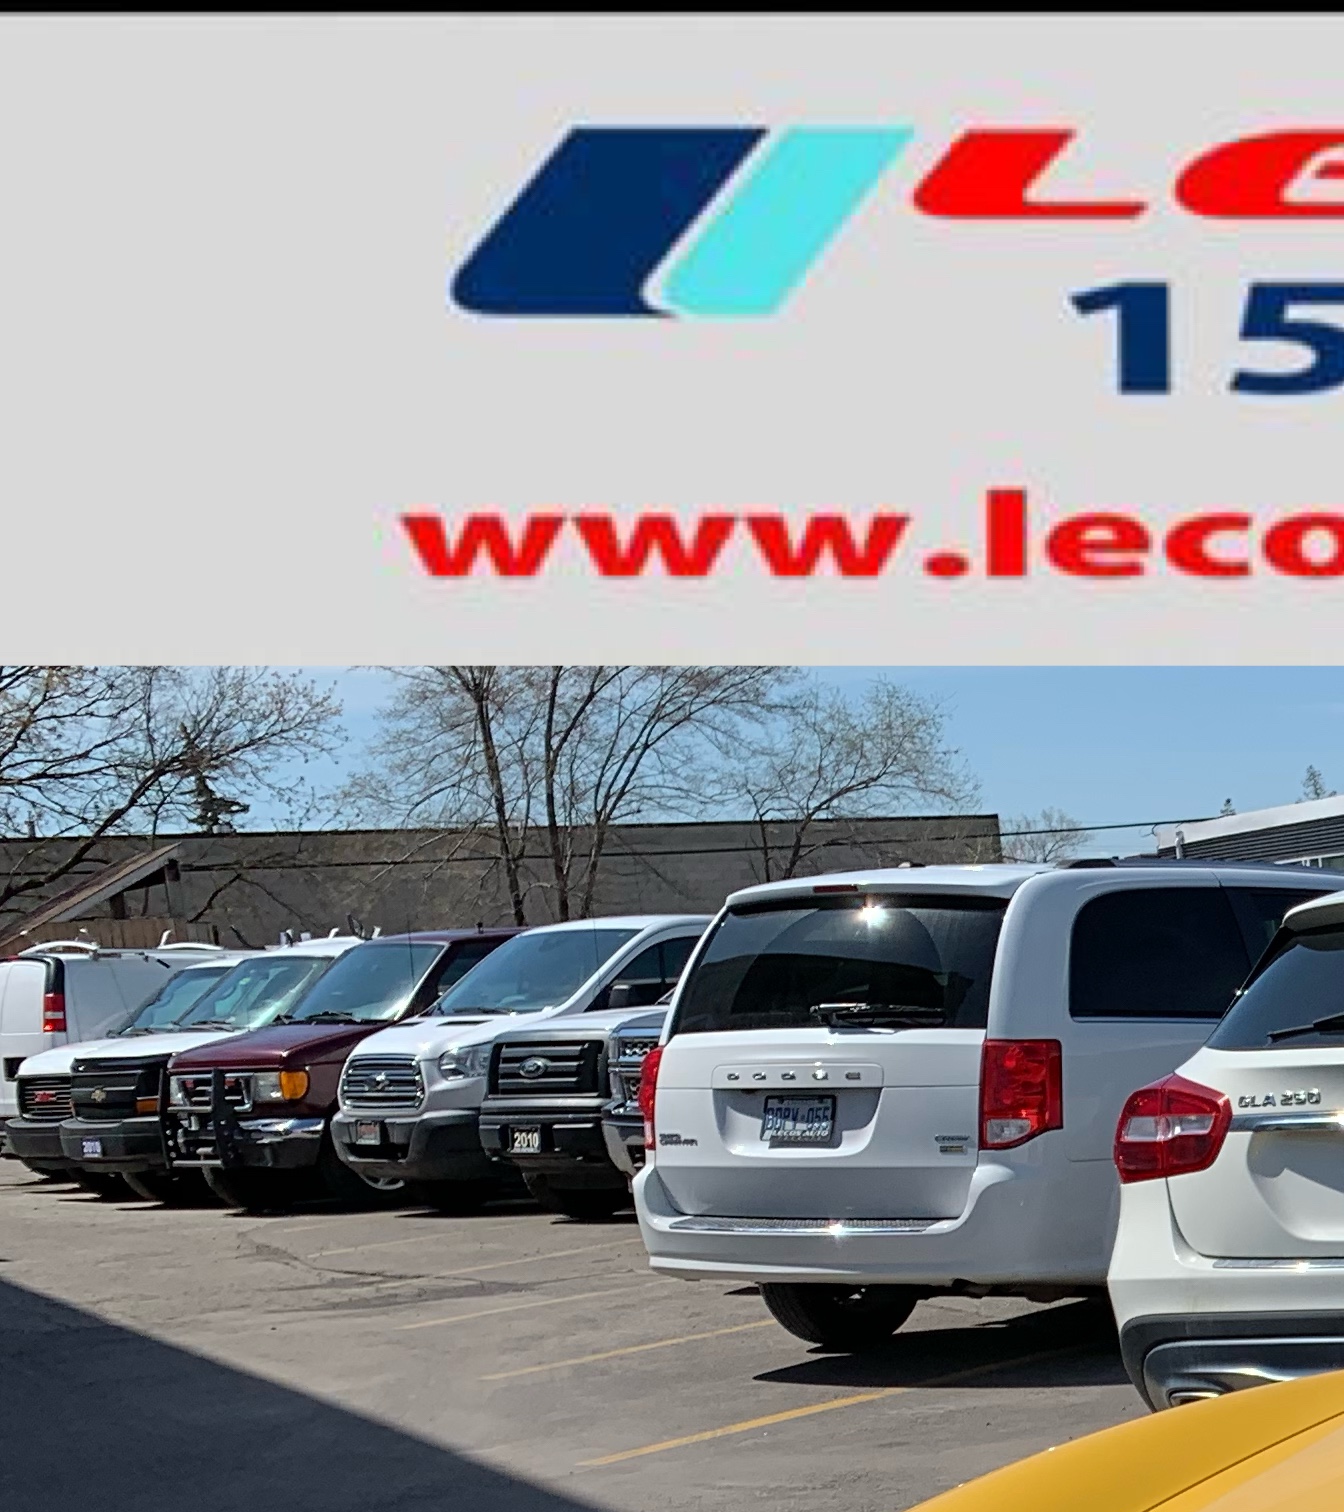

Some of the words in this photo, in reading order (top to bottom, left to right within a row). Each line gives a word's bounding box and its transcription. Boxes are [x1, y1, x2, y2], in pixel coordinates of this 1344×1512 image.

[1238, 1092, 1277, 1108] GLA
[1280, 1087, 1322, 1106] 250
[513, 1131, 540, 1148] 2010
